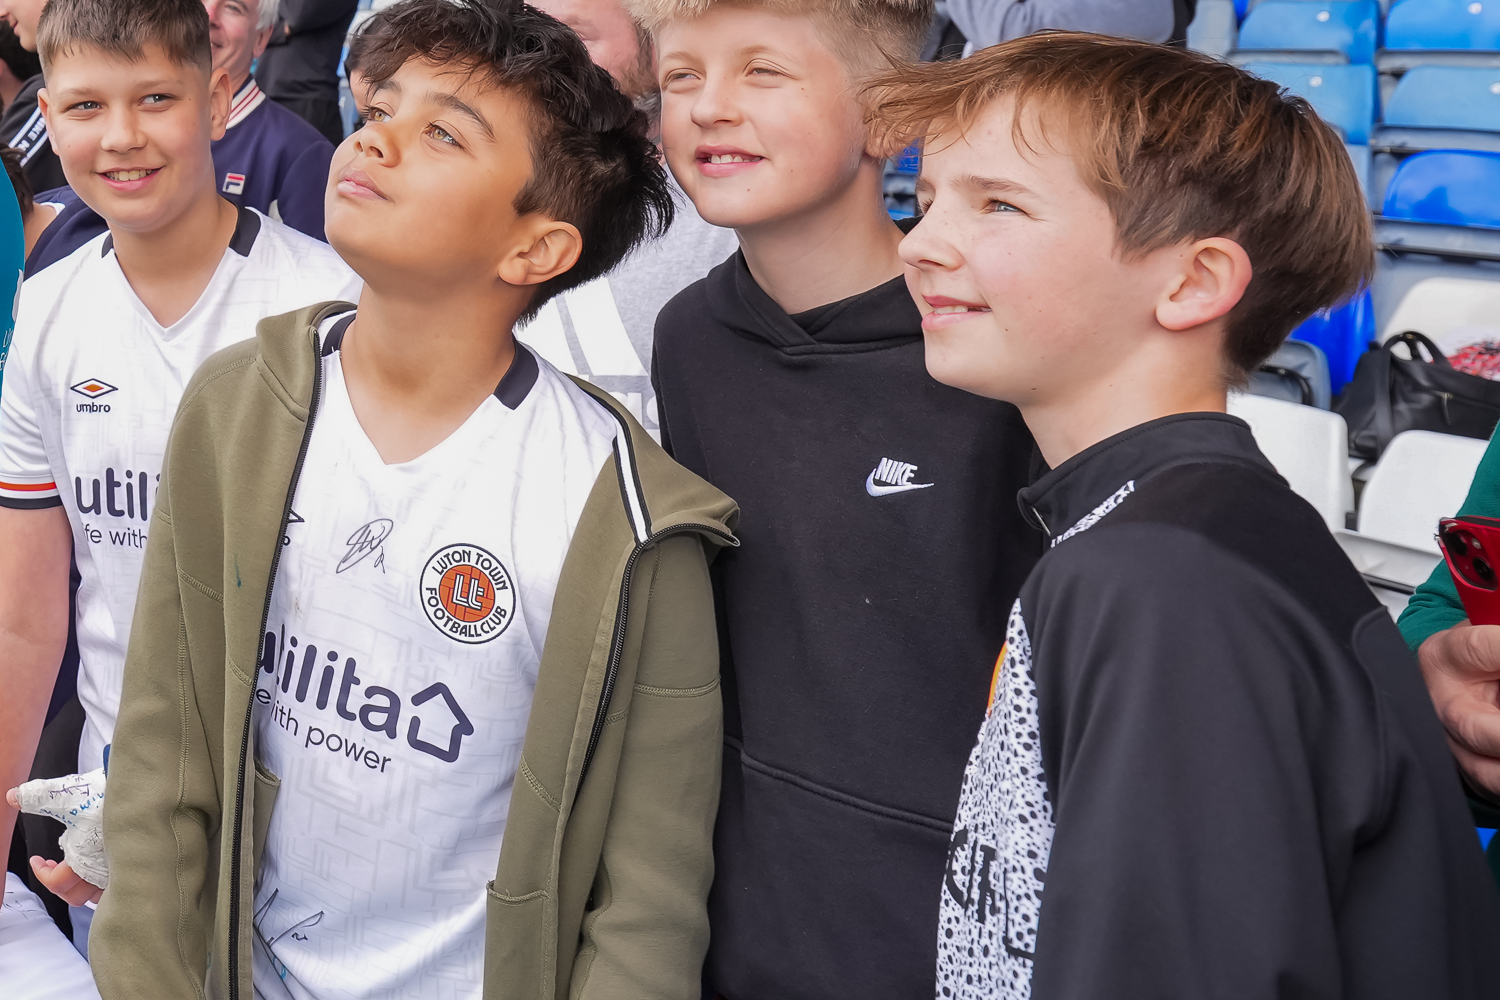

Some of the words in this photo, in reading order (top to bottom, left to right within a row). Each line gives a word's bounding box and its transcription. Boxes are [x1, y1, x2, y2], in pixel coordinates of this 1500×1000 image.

[76, 402, 111, 413] umbro
[874, 457, 918, 486] NIKE
[432, 549, 471, 576] LUTON
[475, 552, 508, 591] TOWN
[270, 700, 299, 736] ith
[304, 725, 392, 773] power
